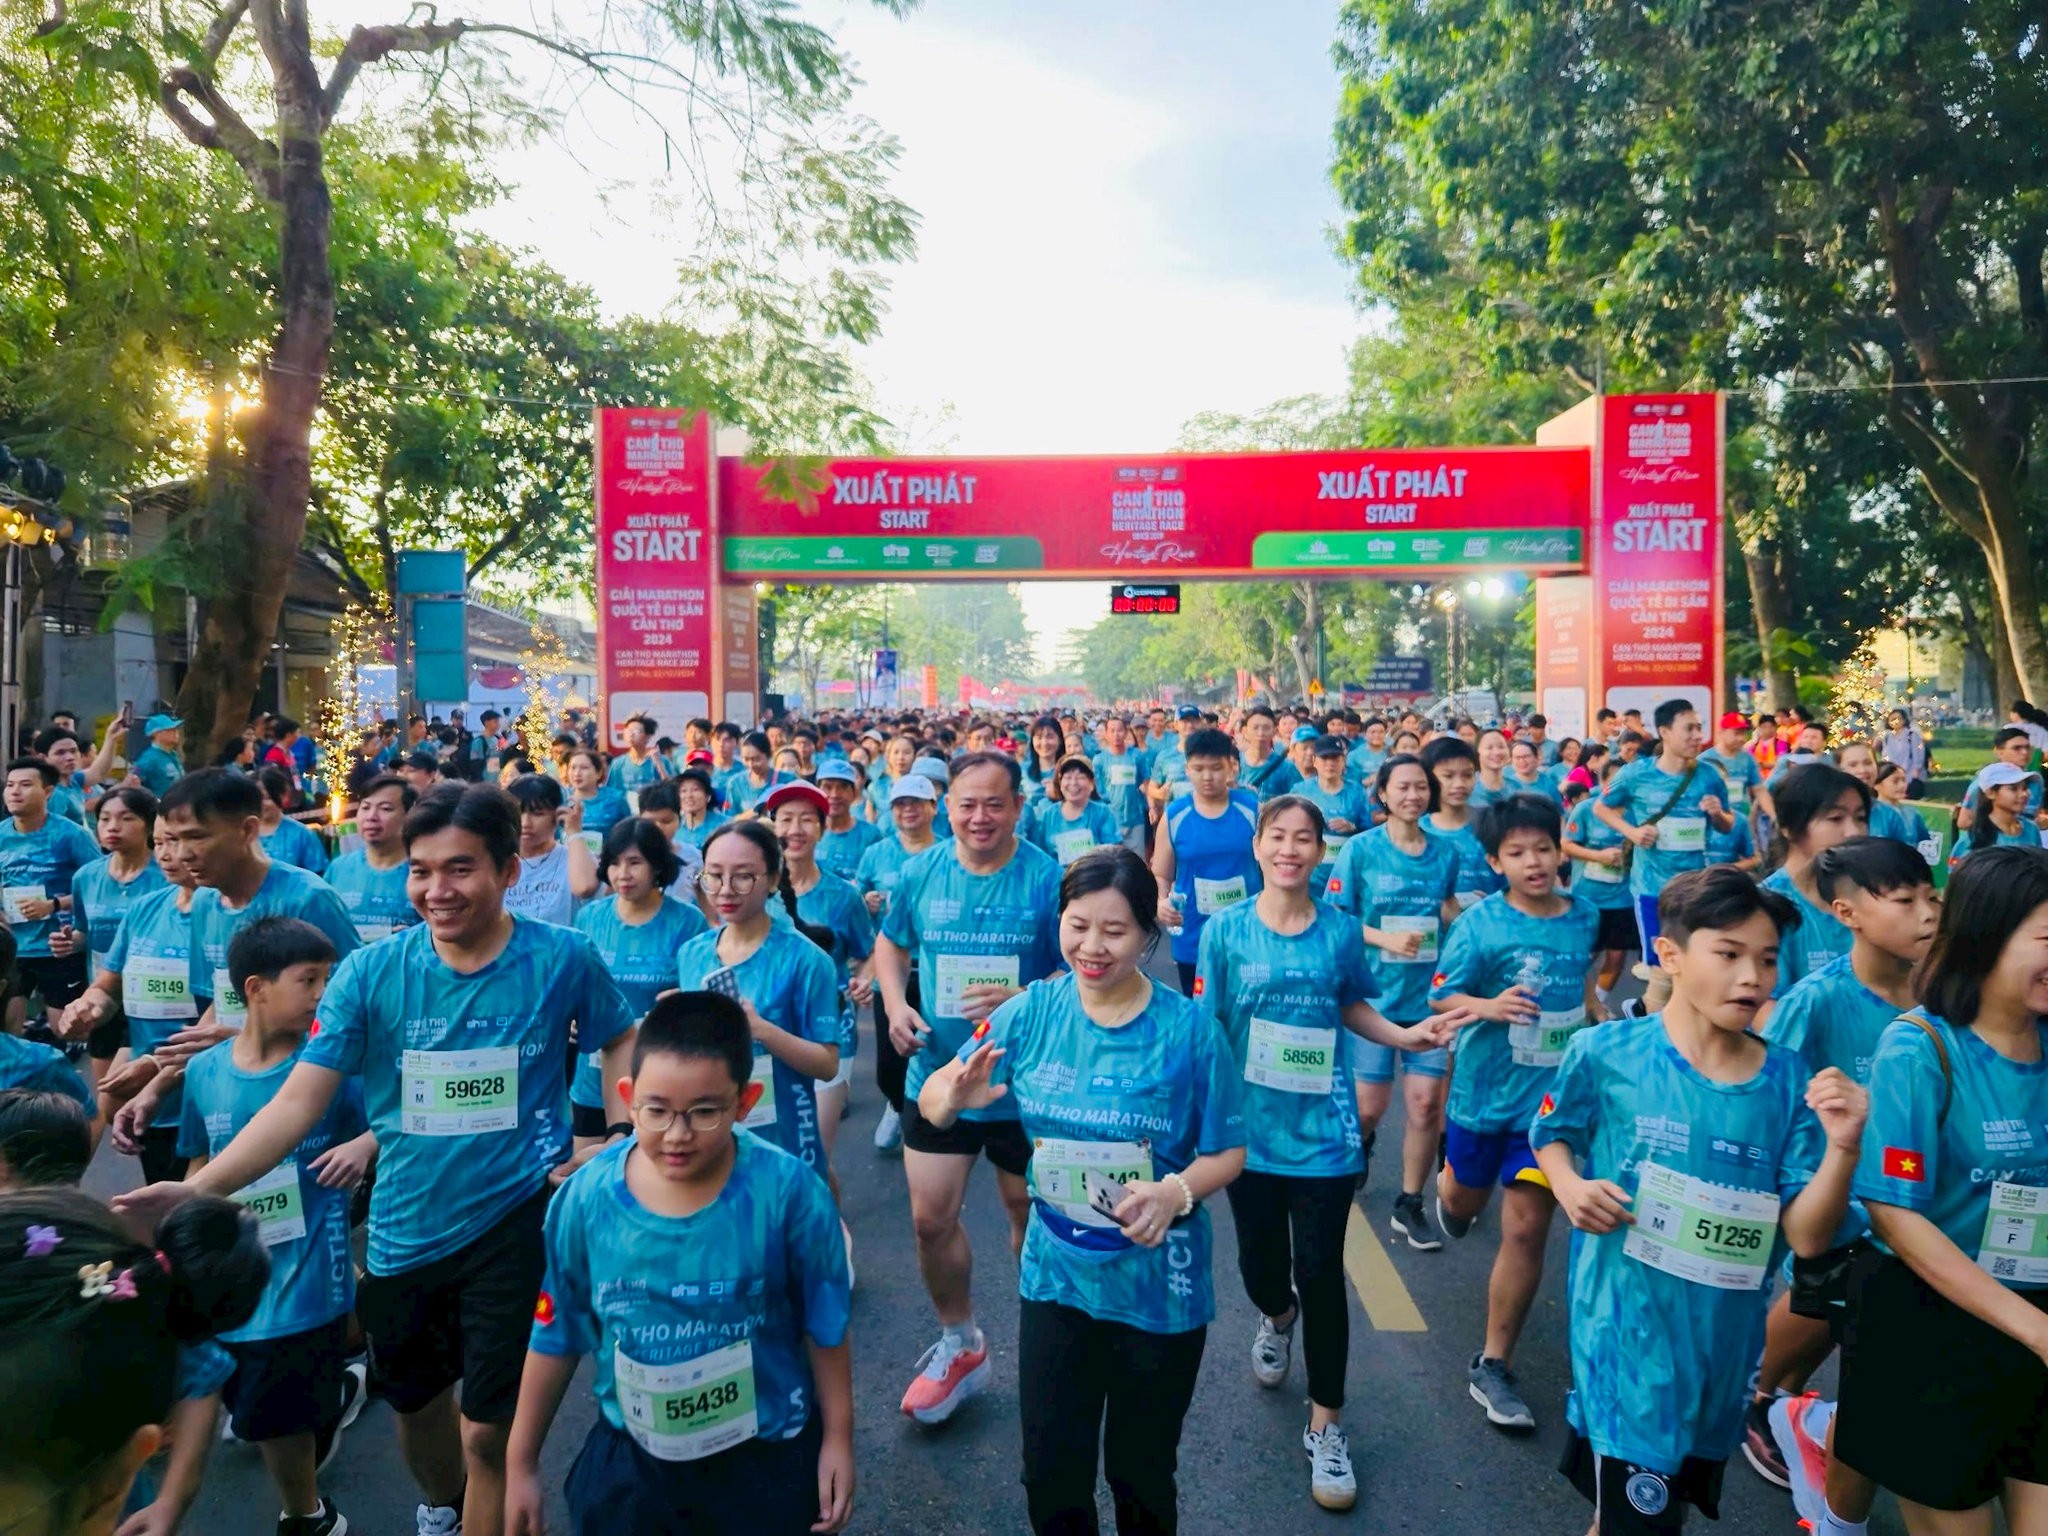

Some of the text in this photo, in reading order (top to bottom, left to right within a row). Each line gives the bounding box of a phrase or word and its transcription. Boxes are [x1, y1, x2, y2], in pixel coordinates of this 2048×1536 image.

[833, 470, 976, 505] XUẤT PHÁT
[1317, 464, 1467, 500] XUẤT PHÁT
[1112, 489, 1185, 507] CAN THO
[1112, 506, 1185, 521] MARATHON
[1365, 503, 1417, 524] START
[1628, 501, 1694, 517] XUẤT PHÁT
[626, 512, 690, 528] XUẤT PHÁT
[880, 509, 930, 529] START
[1112, 520, 1185, 531] HERITAGE RACE
[1613, 518, 1708, 552] START
[612, 529, 702, 562] START
[637, 589, 704, 600] MARATHON
[611, 602, 644, 618] QUỐC
[643, 633, 672, 645] 2024
[1642, 626, 1675, 639] 2024
[944, 931, 969, 943] THO
[148, 979, 184, 994] 58149
[1282, 1048, 1325, 1065] 58563
[445, 1076, 506, 1100] 59628
[415, 1093, 424, 1104] M
[1049, 1103, 1083, 1122] THO
[1083, 1107, 1174, 1133] MARATHON
[1970, 1167, 2015, 1183] CAN
[1051, 1181, 1059, 1193] F
[1652, 1217, 1666, 1232] M
[2007, 1217, 2025, 1226] 5KM
[1695, 1219, 1763, 1250] 51256
[2008, 1233, 2018, 1245] F
[325, 1193, 346, 1304] #CTHM
[631, 1324, 670, 1345] THO
[665, 1381, 740, 1421] 55438
